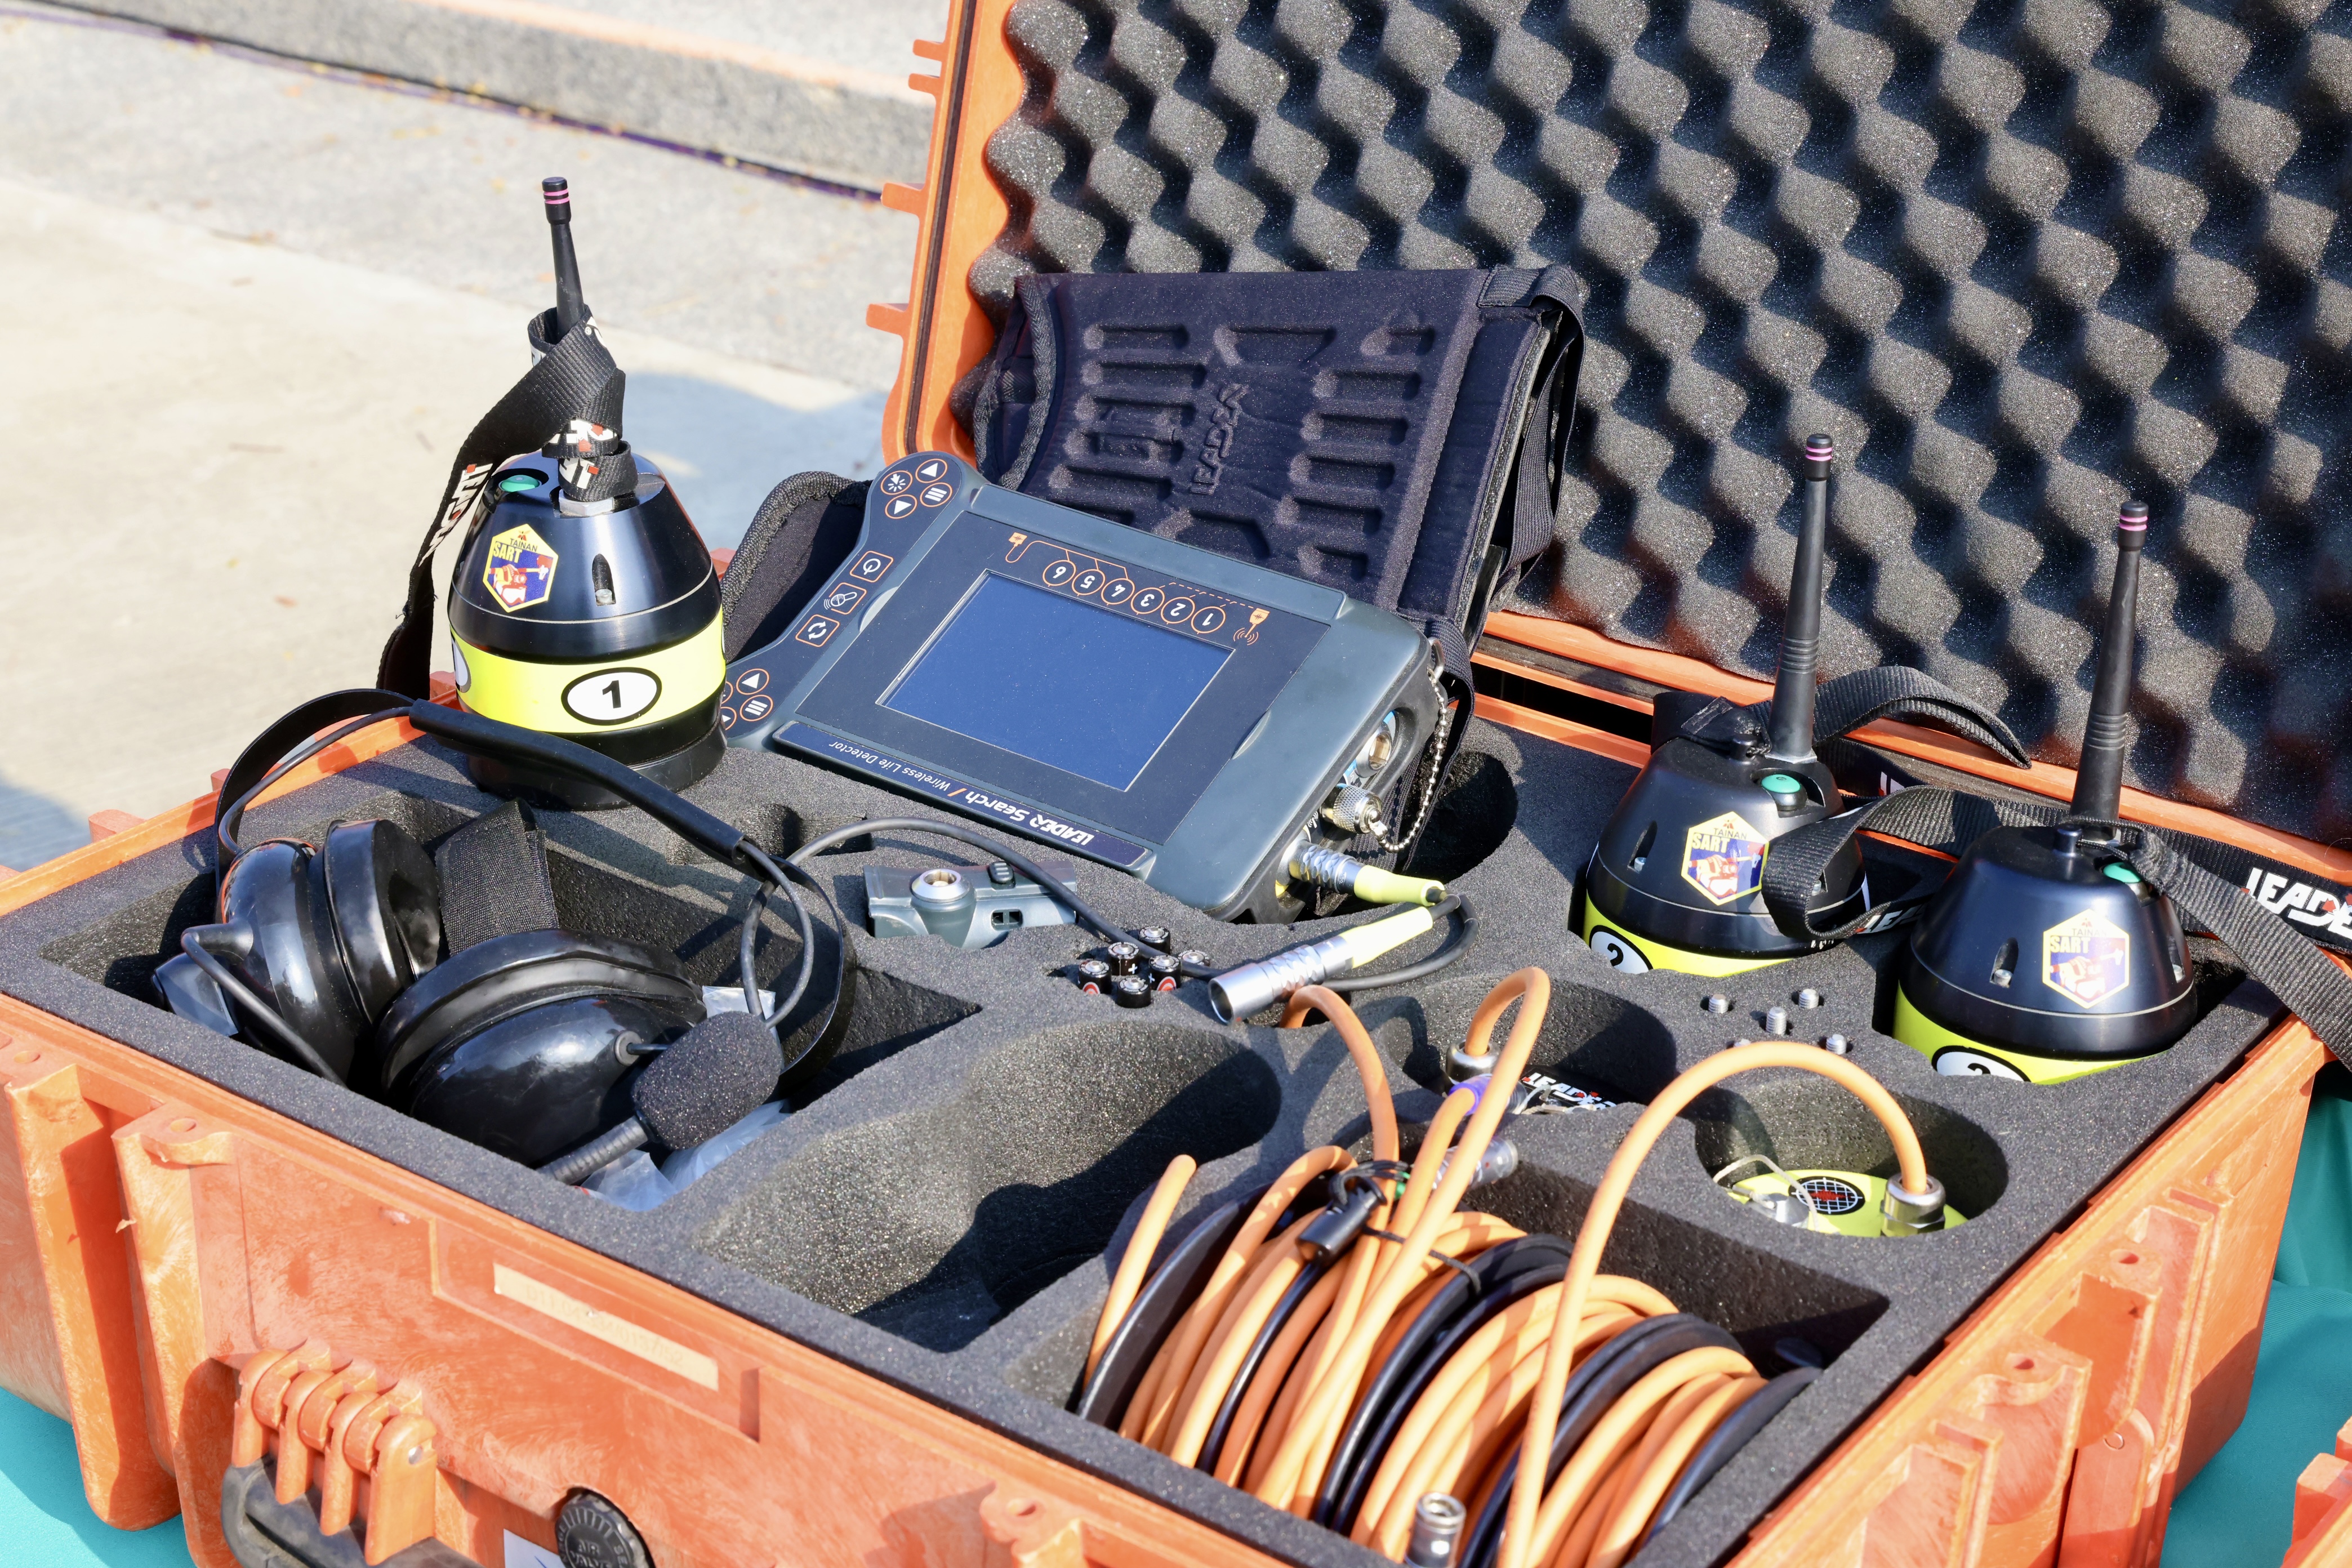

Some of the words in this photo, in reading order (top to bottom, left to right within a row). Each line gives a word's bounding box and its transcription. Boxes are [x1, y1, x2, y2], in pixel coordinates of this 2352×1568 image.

[1190, 383, 1249, 495] LEADER
[493, 541, 523, 563] SART
[510, 538, 538, 552] TAINAN
[1052, 565, 1067, 579] 6
[1080, 574, 1095, 589] 5
[1111, 583, 1126, 598] 4
[1140, 593, 1155, 607] 3
[1170, 602, 1186, 617] 2
[1202, 612, 1214, 626] 1
[602, 680, 622, 709] 1
[828, 741, 879, 764] Detector
[879, 758, 902, 773] Life
[902, 767, 951, 792] Wireless
[964, 791, 1031, 822] Search
[1029, 814, 1095, 846] LEADER
[1713, 828, 1747, 840] TAINAN
[1691, 832, 1731, 853] SART
[2072, 928, 2107, 937] TAINAN
[2050, 935, 2091, 954] SART
